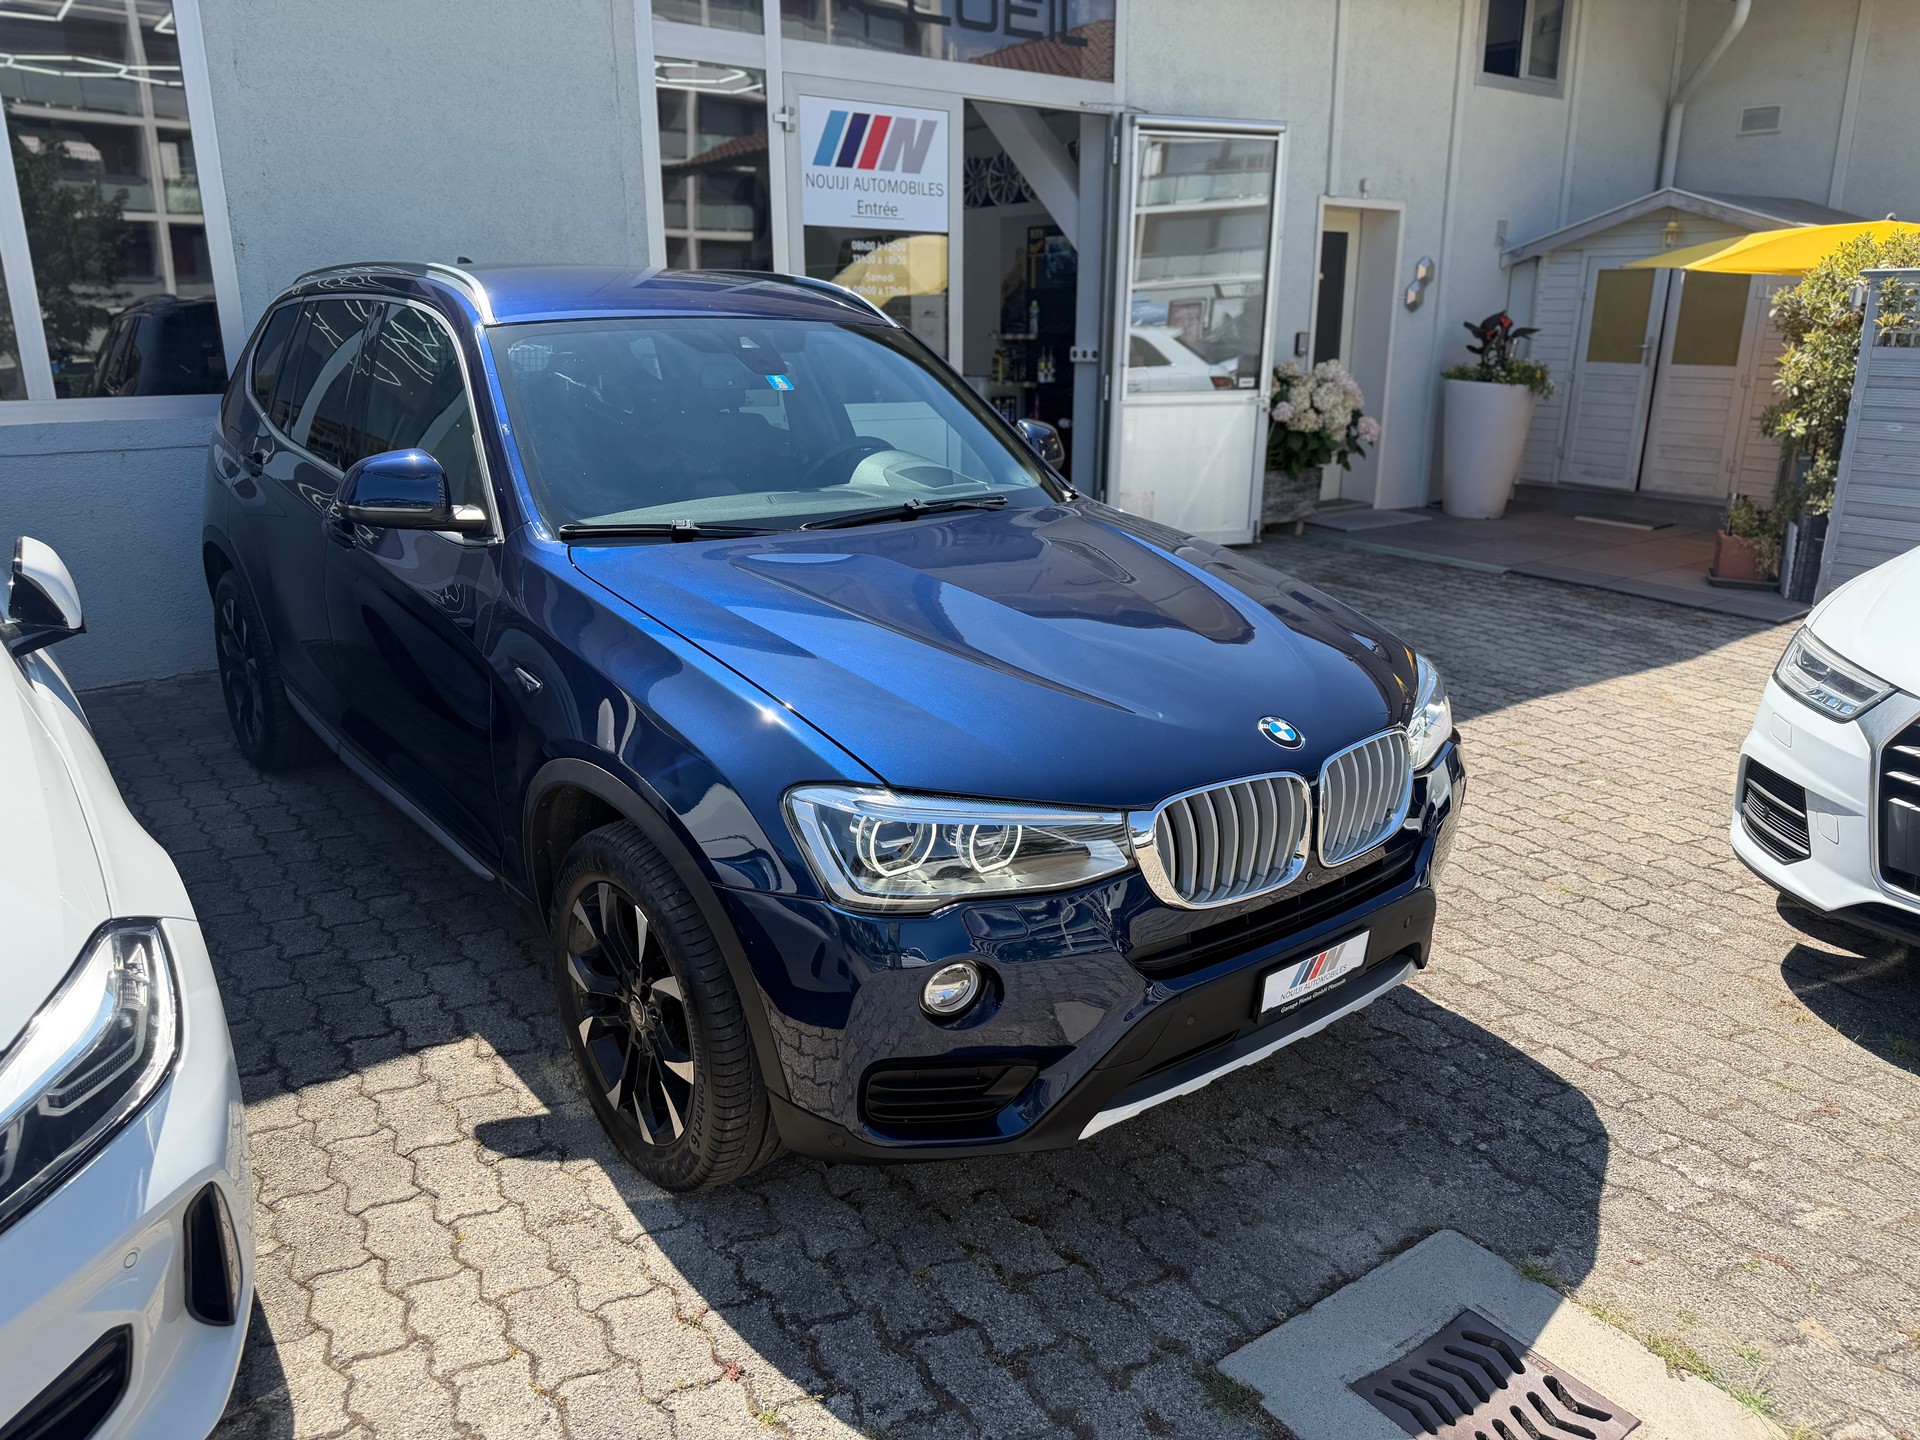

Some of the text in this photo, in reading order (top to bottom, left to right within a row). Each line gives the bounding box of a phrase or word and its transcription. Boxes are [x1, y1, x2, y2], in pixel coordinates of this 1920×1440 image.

[805, 173, 944, 198] NOUIJI AUTOMOBILES
[857, 200, 898, 217] Entrée
[866, 272, 895, 282] Samedi
[1303, 963, 1348, 991] AUTOMOBILES
[1280, 1001, 1298, 1014] Garage
[690, 1134, 700, 1149] 6
